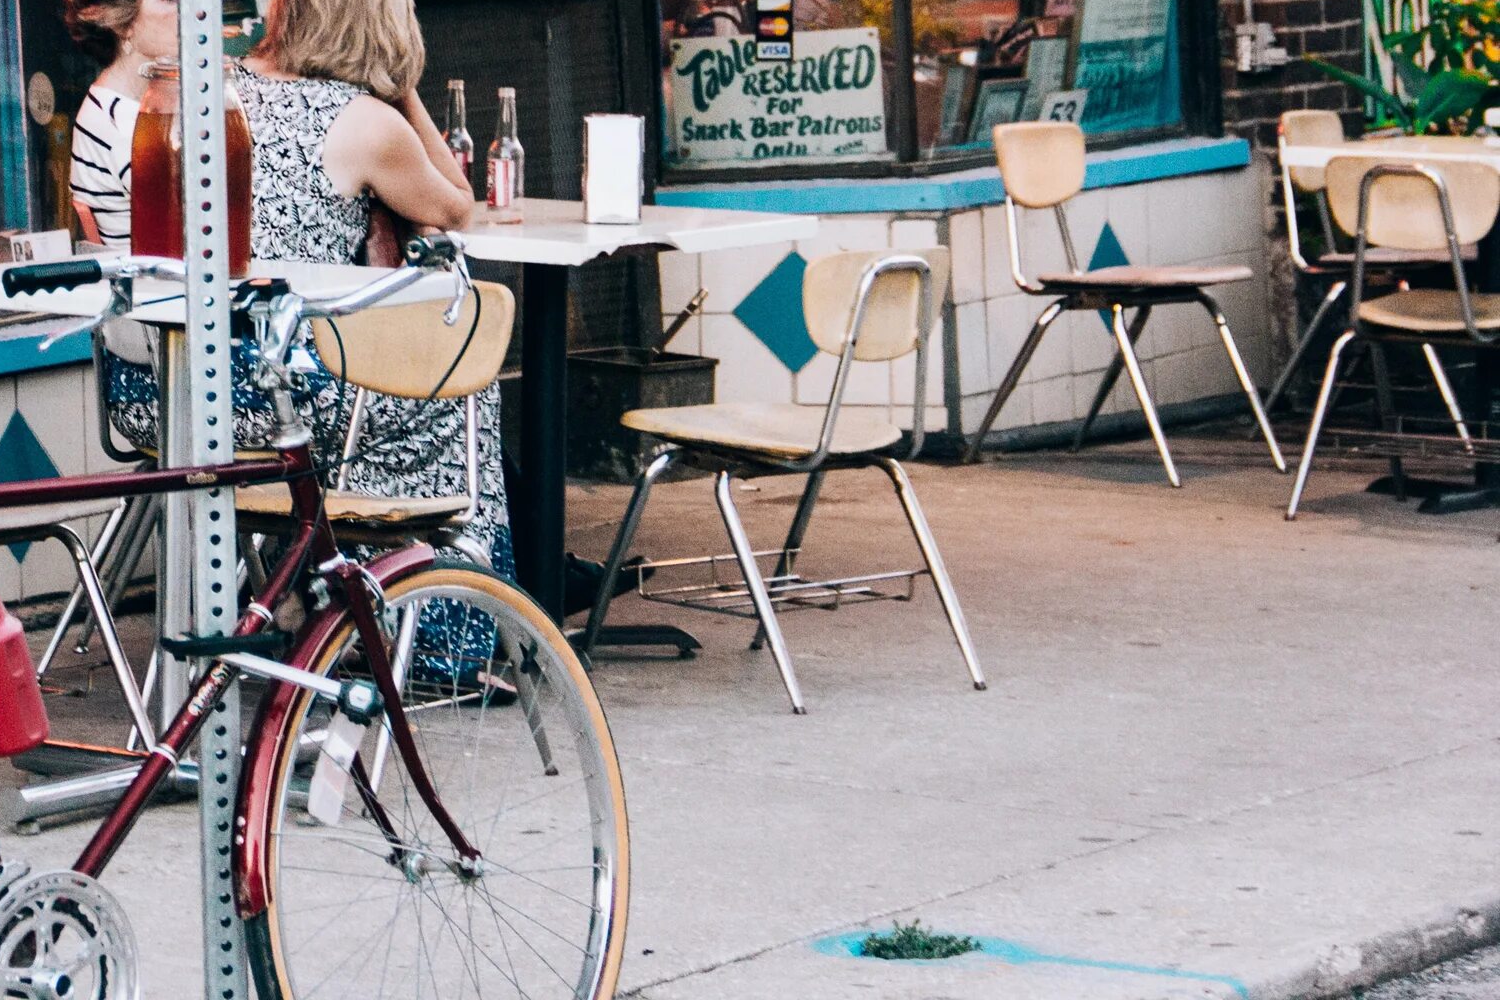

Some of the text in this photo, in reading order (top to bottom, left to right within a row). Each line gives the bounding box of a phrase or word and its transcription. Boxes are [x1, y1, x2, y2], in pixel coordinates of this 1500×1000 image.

[762, 45, 789, 55] VISA
[676, 38, 757, 112] Table
[742, 44, 876, 98] RESERVED
[766, 97, 803, 115] For
[681, 114, 883, 142] Snack Bar Patrons
